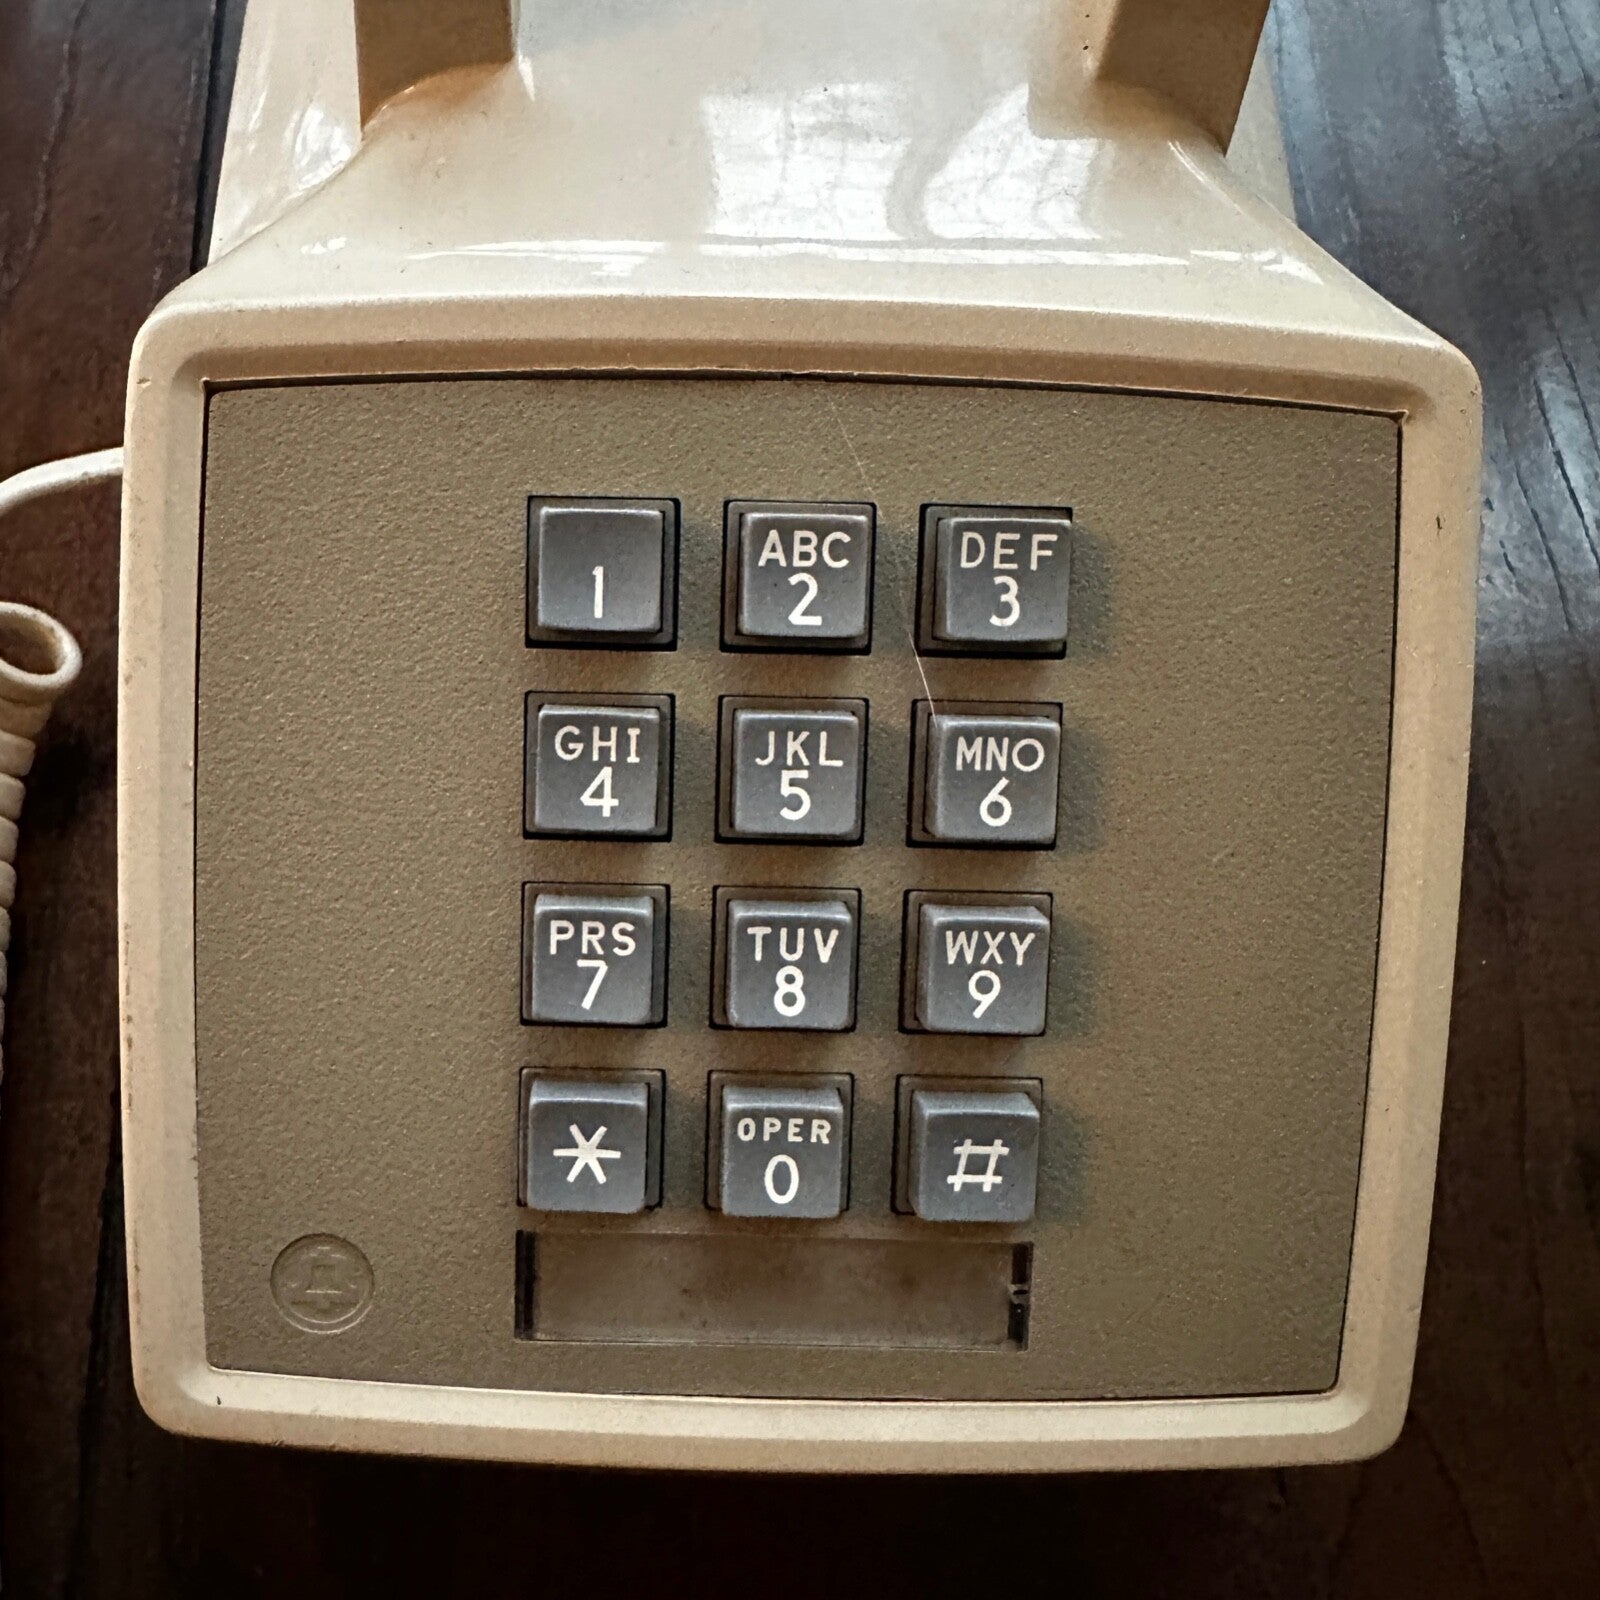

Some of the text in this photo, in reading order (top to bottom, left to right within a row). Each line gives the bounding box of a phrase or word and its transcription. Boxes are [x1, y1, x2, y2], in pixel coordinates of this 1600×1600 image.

[757, 529, 851, 569] ABC
[960, 531, 1058, 571] DEF
[592, 565, 604, 619] 1
[787, 572, 823, 627] 2
[989, 575, 1021, 627] 3
[554, 725, 641, 764] GHI
[754, 731, 844, 768] JKL
[956, 736, 1045, 772] MNO
[579, 766, 620, 818] 4
[779, 769, 812, 822] 5
[979, 776, 1013, 828] 6
[549, 920, 636, 957] PRS
[747, 926, 839, 964] TUV
[945, 930, 1036, 966] WXY
[576, 958, 609, 1011] 7
[773, 965, 806, 1018] 8
[968, 969, 1002, 1019] 9
[737, 1117, 831, 1145] OPER
[763, 1154, 800, 1205] 0
[946, 1139, 1010, 1193] #
